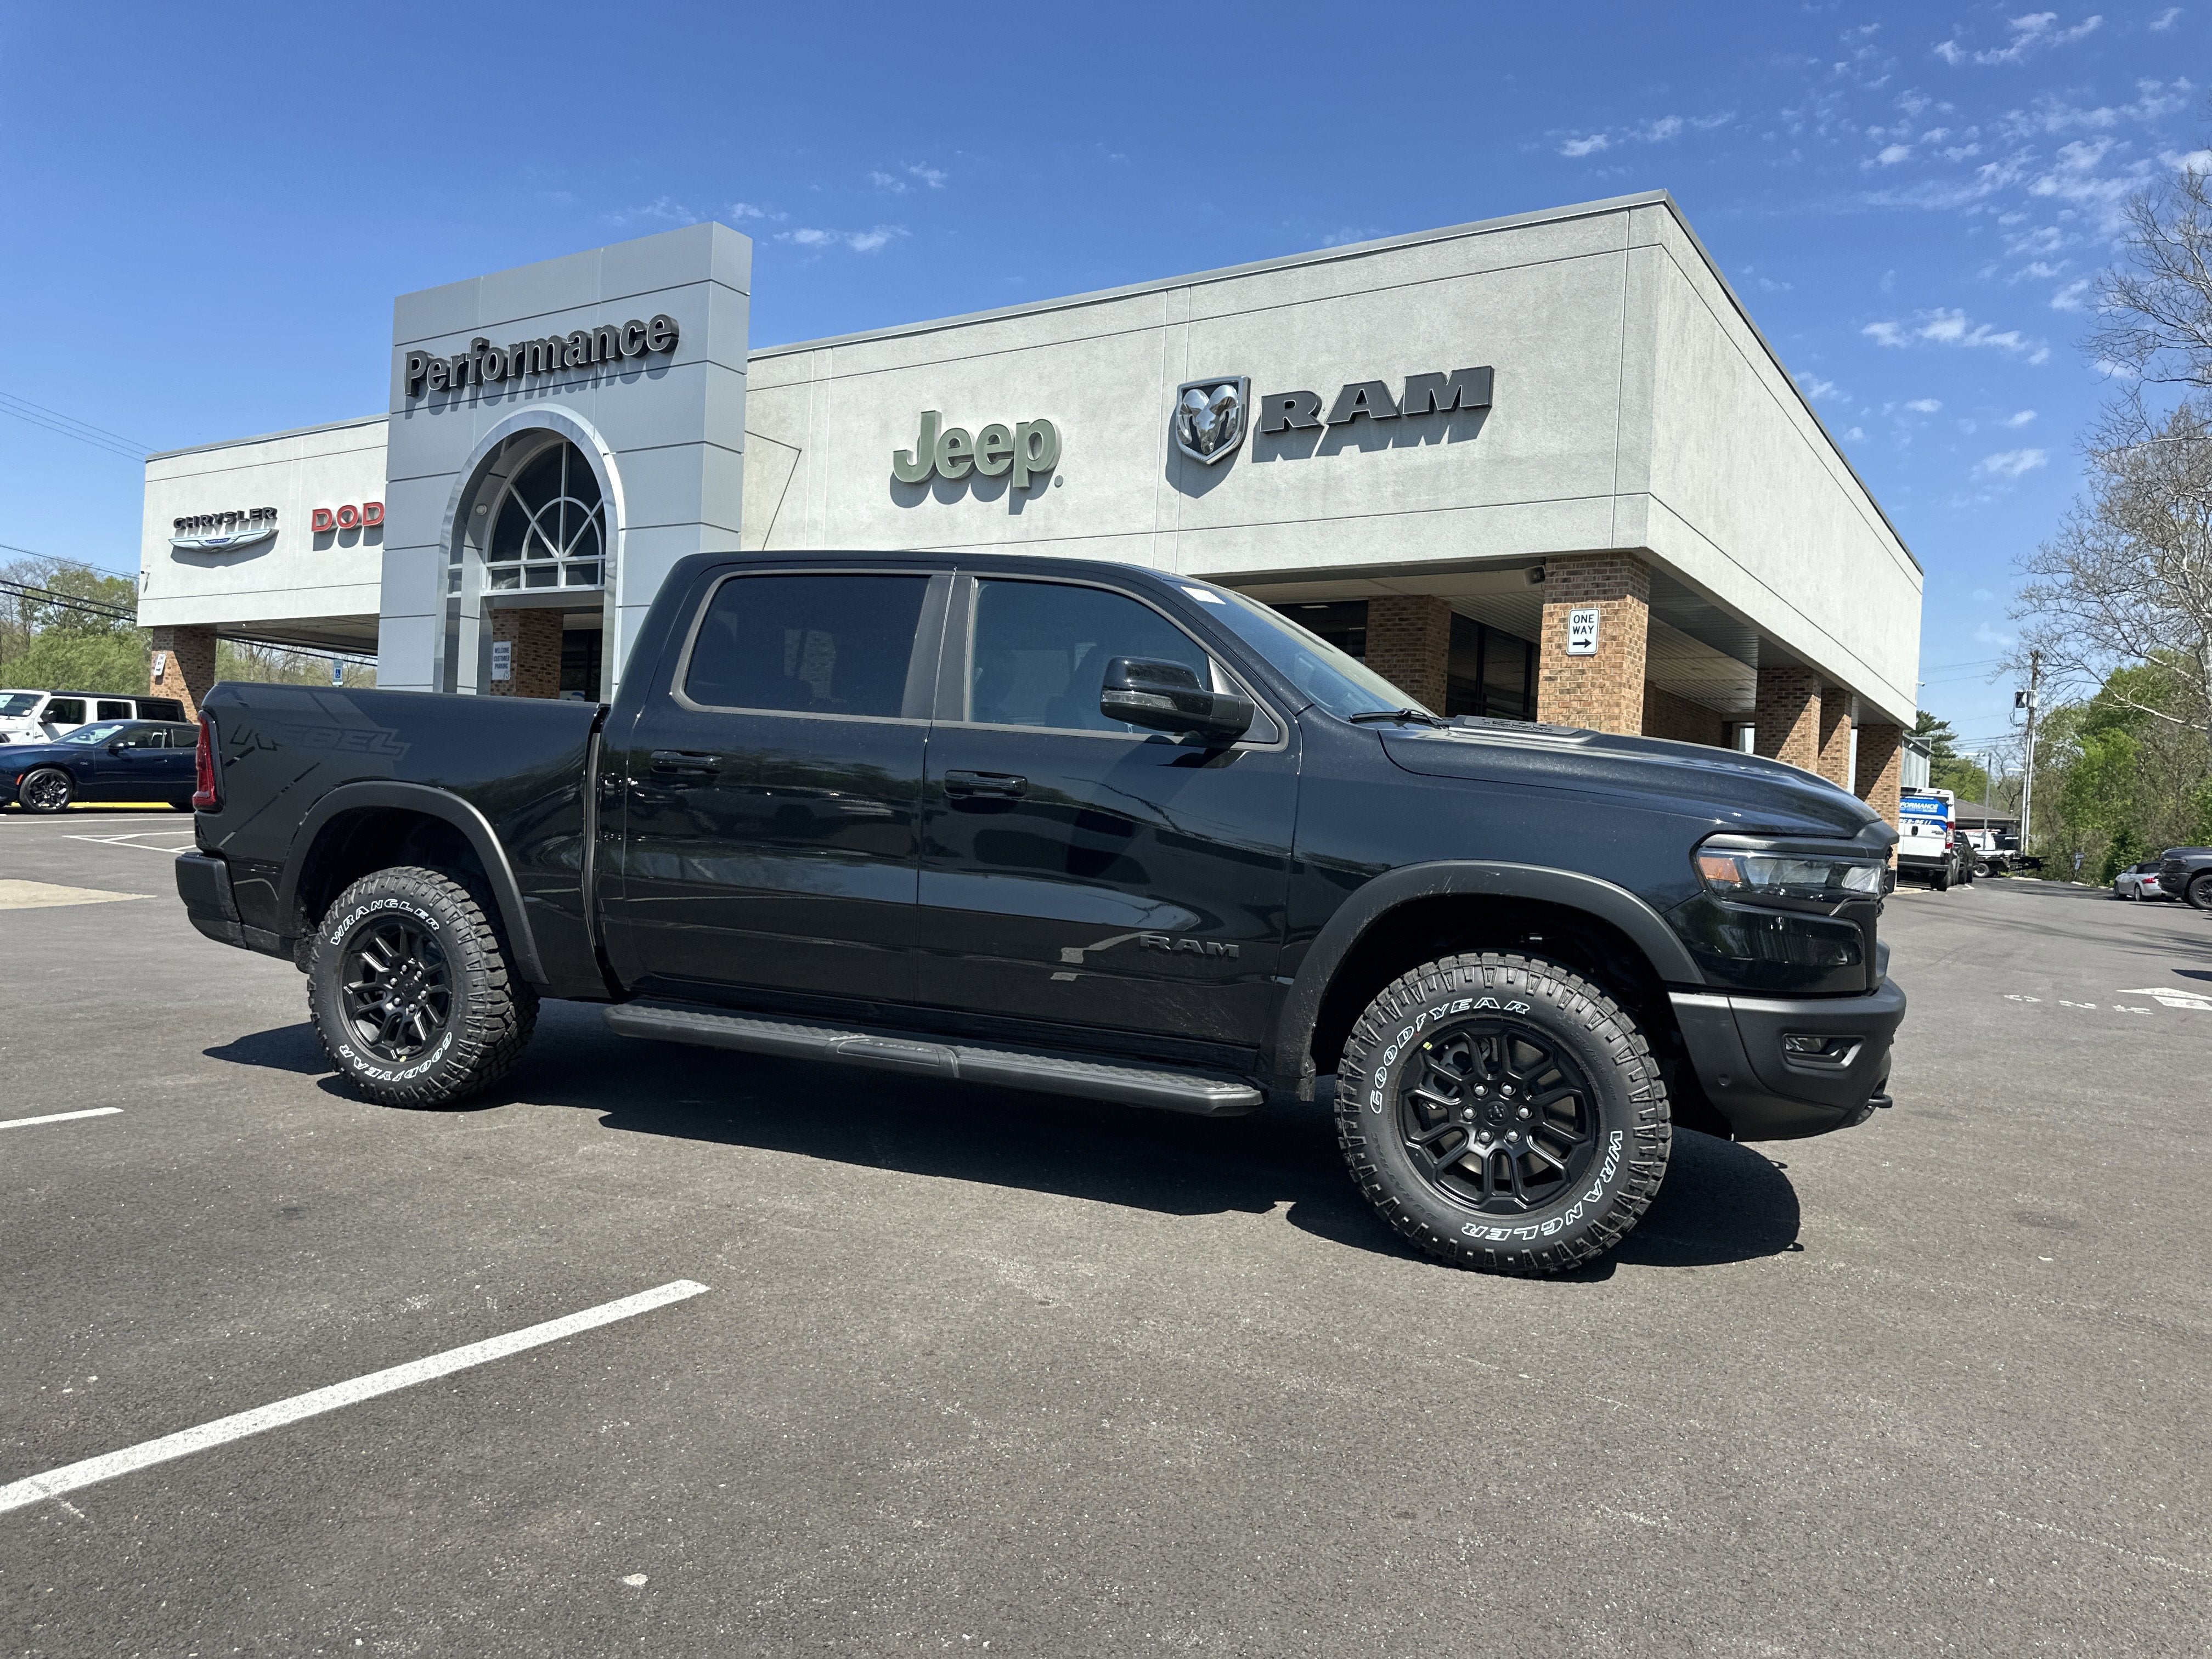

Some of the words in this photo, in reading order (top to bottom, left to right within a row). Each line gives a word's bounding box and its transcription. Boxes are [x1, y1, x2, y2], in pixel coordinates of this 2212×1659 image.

[404, 314, 679, 396] Performance
[1260, 366, 1494, 434] RAM
[893, 410, 1062, 489] Jeep
[173, 507, 278, 529] CHRYSLER
[312, 501, 385, 532] DOD
[1572, 625, 1594, 635] WAY
[1573, 614, 1595, 624] ONE
[330, 898, 440, 946] WRANGLER
[1139, 934, 1239, 958] RAM
[339, 1032, 453, 1082] GOODYEAR
[1370, 997, 1531, 1114] GOODYEAR
[1462, 1130, 1623, 1241] WRANGLER
